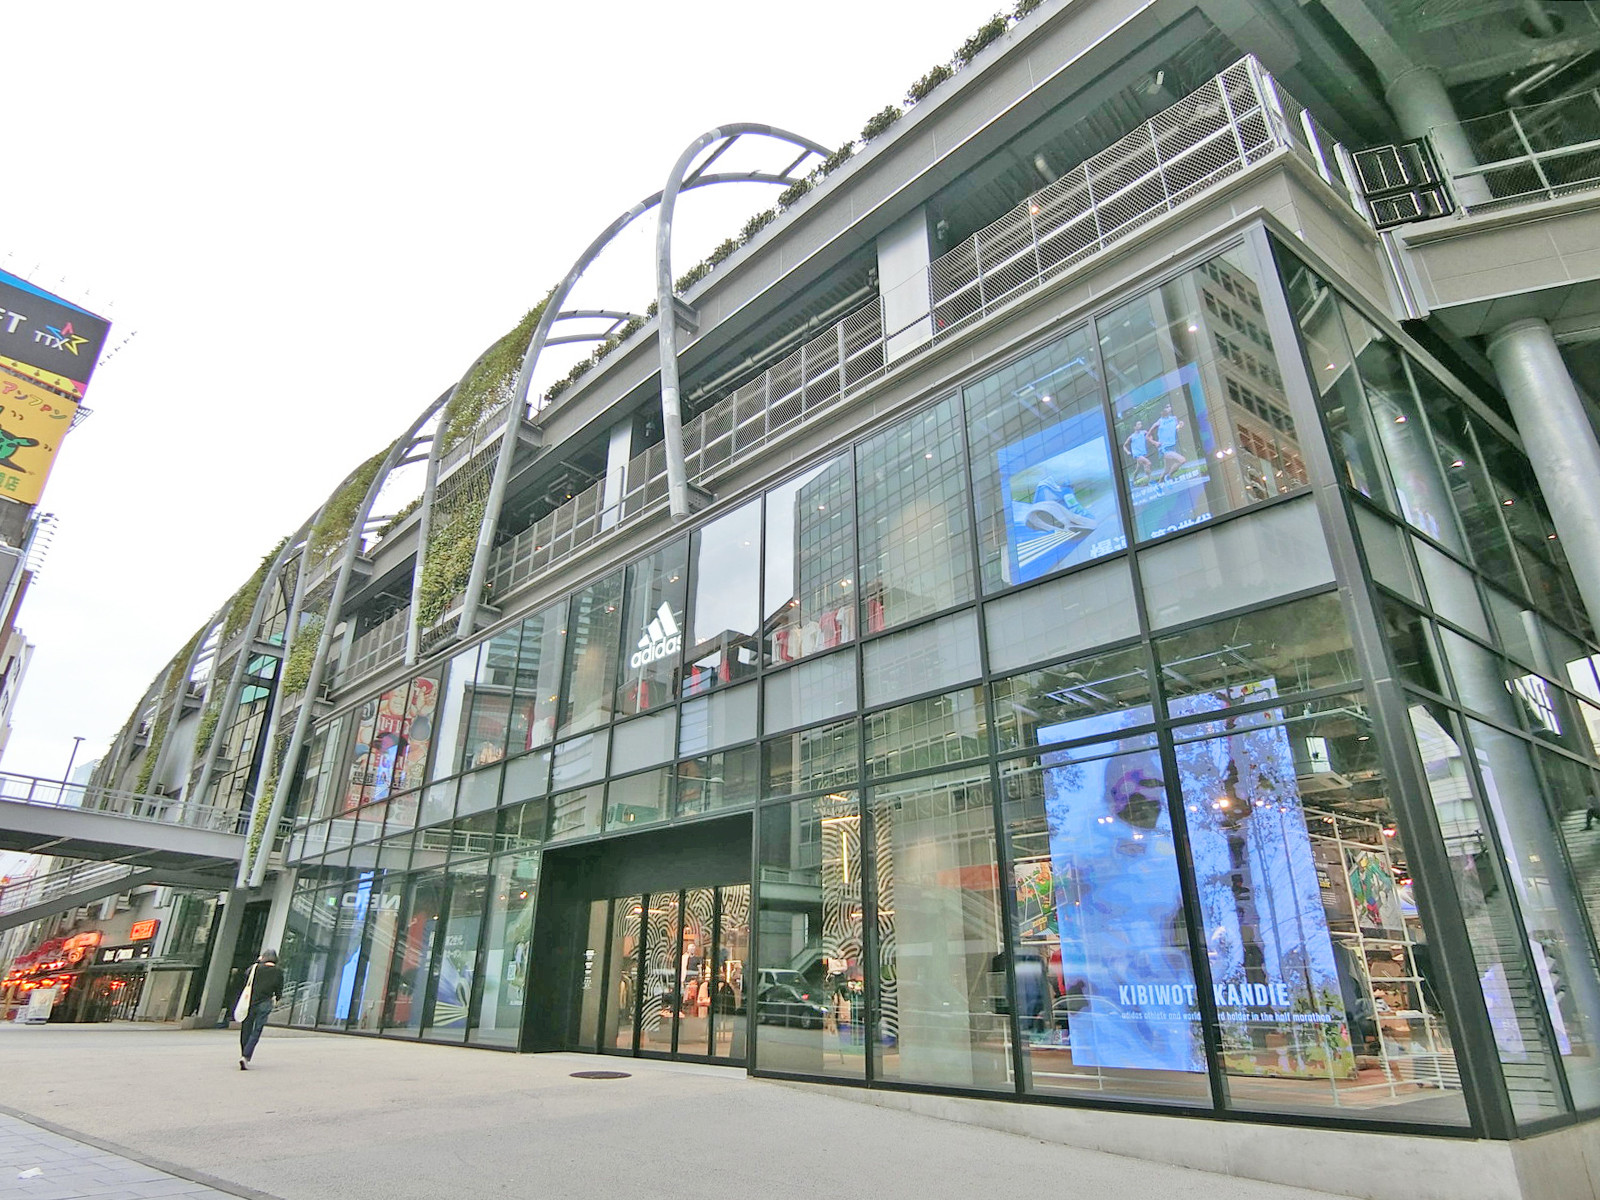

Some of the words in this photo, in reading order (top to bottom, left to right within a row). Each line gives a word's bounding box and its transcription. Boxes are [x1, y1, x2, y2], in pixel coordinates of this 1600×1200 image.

[34, 330, 70, 351] TTX
[631, 634, 682, 668] adidas
[1119, 984, 1198, 1006] KIBIWOT
[1212, 983, 1291, 1006] KANDIE
[1121, 1011, 1142, 1020] adidas
[1143, 1011, 1167, 1020] athlete
[1168, 1011, 1181, 1020] and
[1226, 1012, 1250, 1022] holder
[1251, 1012, 1260, 1021] in
[1260, 1012, 1274, 1021] the
[1274, 1012, 1291, 1022] half
[1292, 1013, 1332, 1023] marathon
